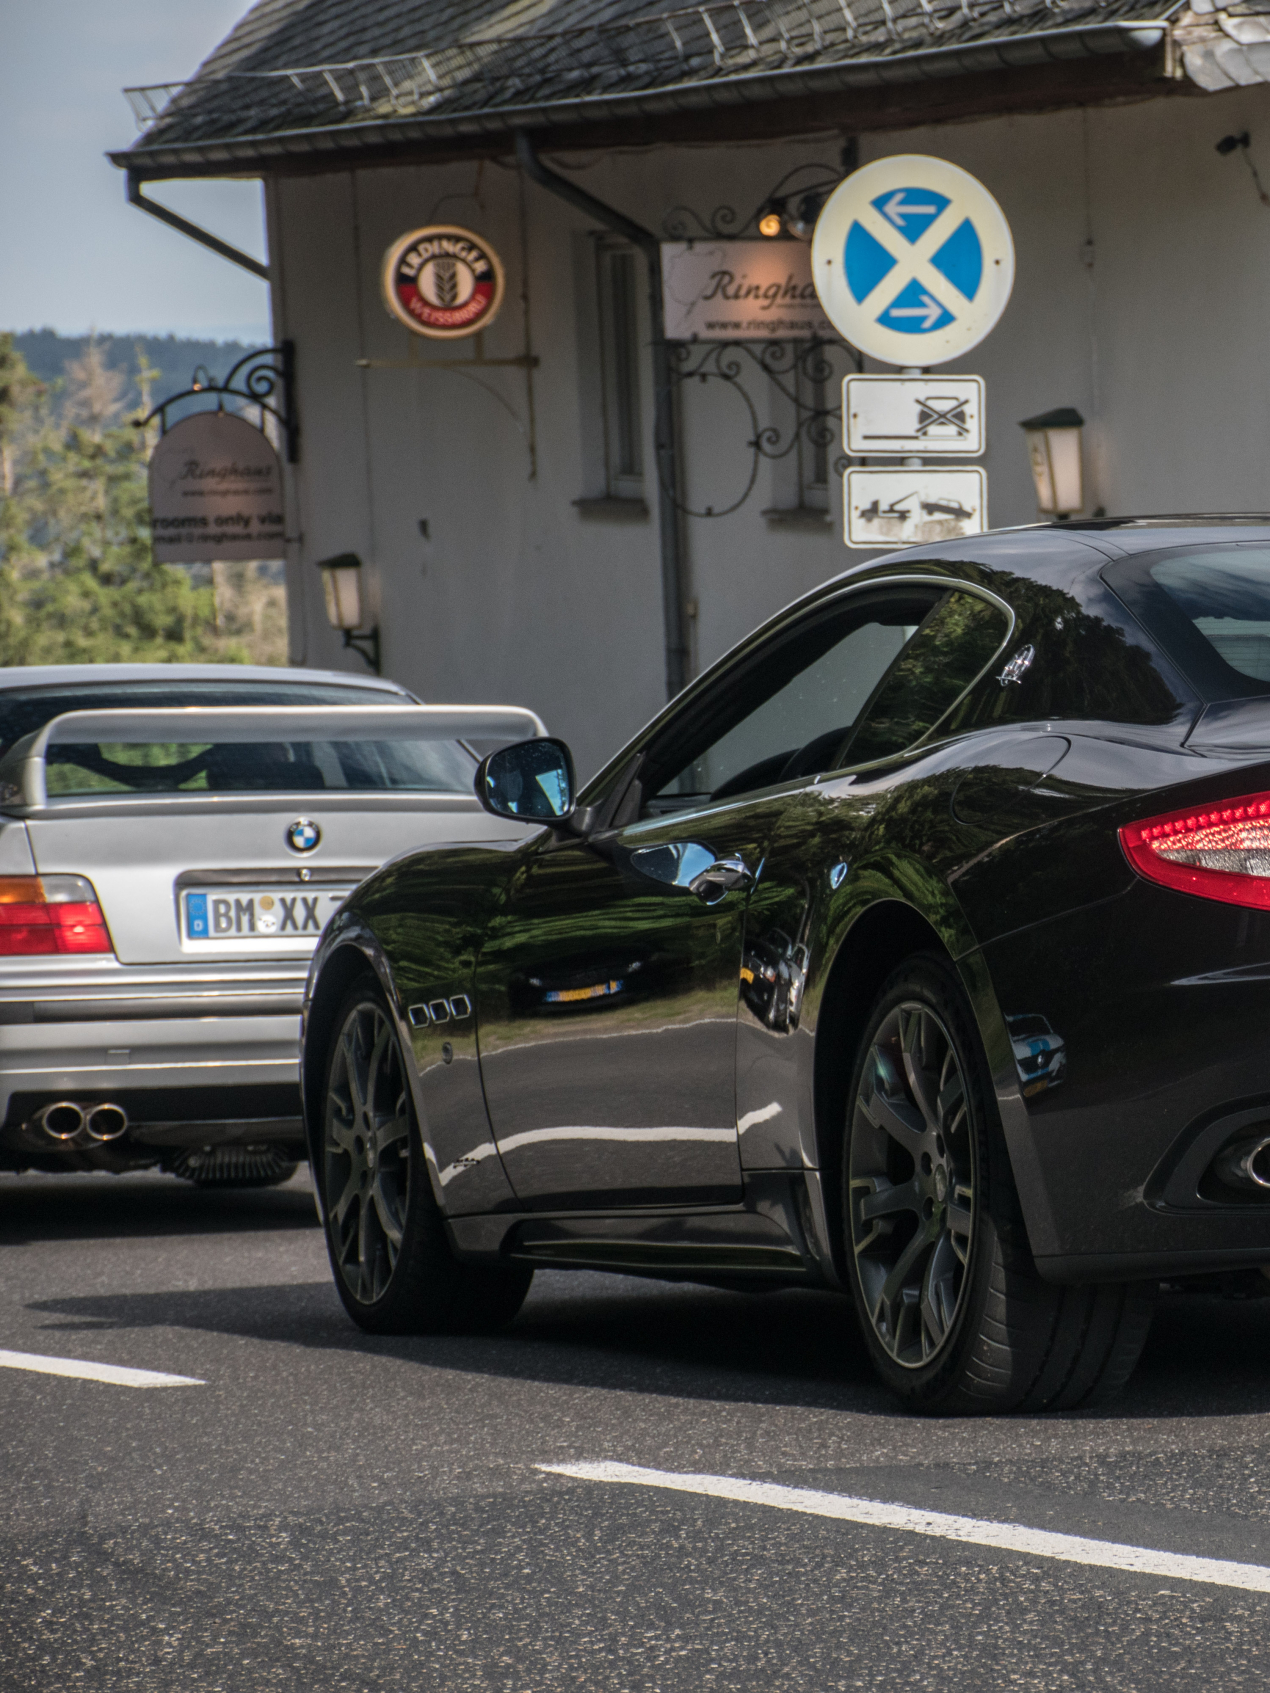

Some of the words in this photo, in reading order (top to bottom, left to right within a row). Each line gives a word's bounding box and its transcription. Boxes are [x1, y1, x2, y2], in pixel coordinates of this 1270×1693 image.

[400, 238, 488, 276] ERDINGER
[703, 270, 819, 310] Ringha
[152, 516, 208, 529] rooms
[214, 513, 251, 529] only
[212, 899, 256, 933] BM
[278, 897, 321, 931] XX
